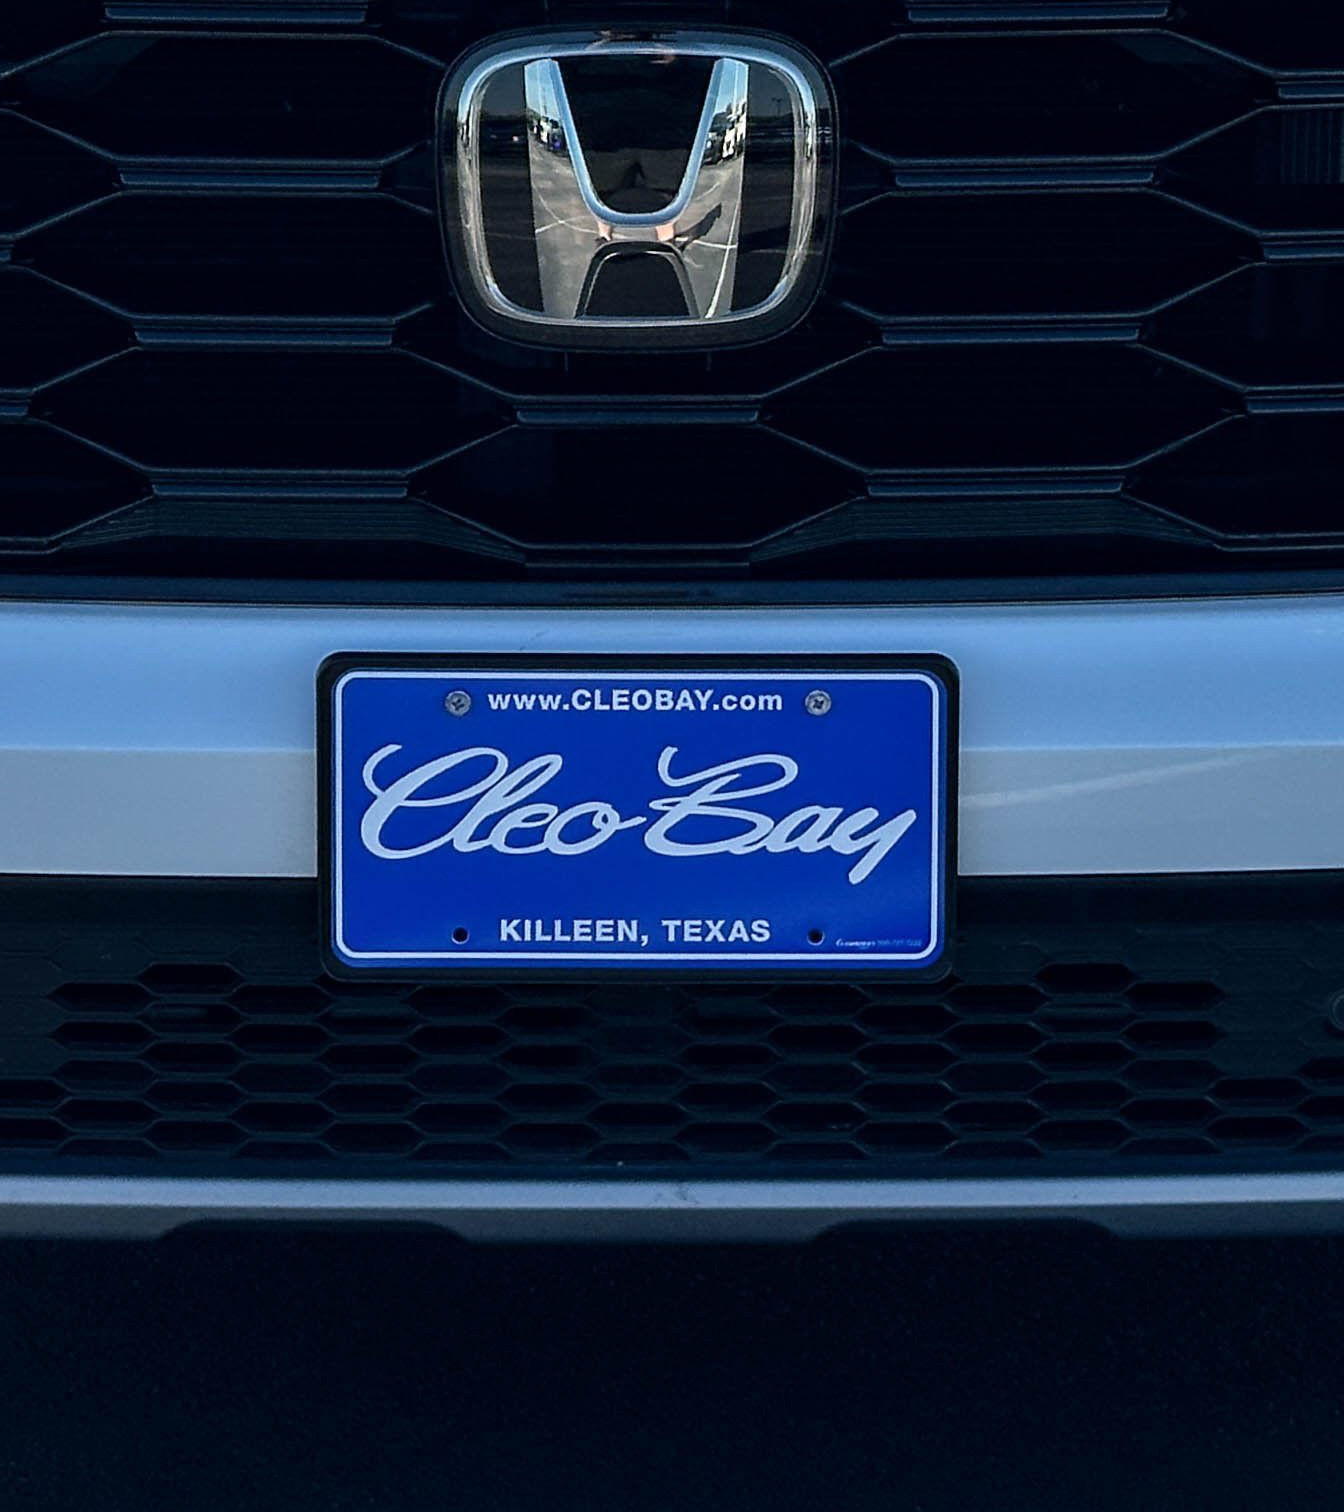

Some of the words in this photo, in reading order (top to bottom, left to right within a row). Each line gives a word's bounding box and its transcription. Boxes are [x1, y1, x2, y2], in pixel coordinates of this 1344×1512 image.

[487, 688, 784, 712] www.CLEOBAY.com
[360, 743, 647, 860] Cleo
[643, 745, 918, 885] Bay
[499, 919, 650, 947] KILLEEN,
[661, 919, 772, 944] TEXAS
